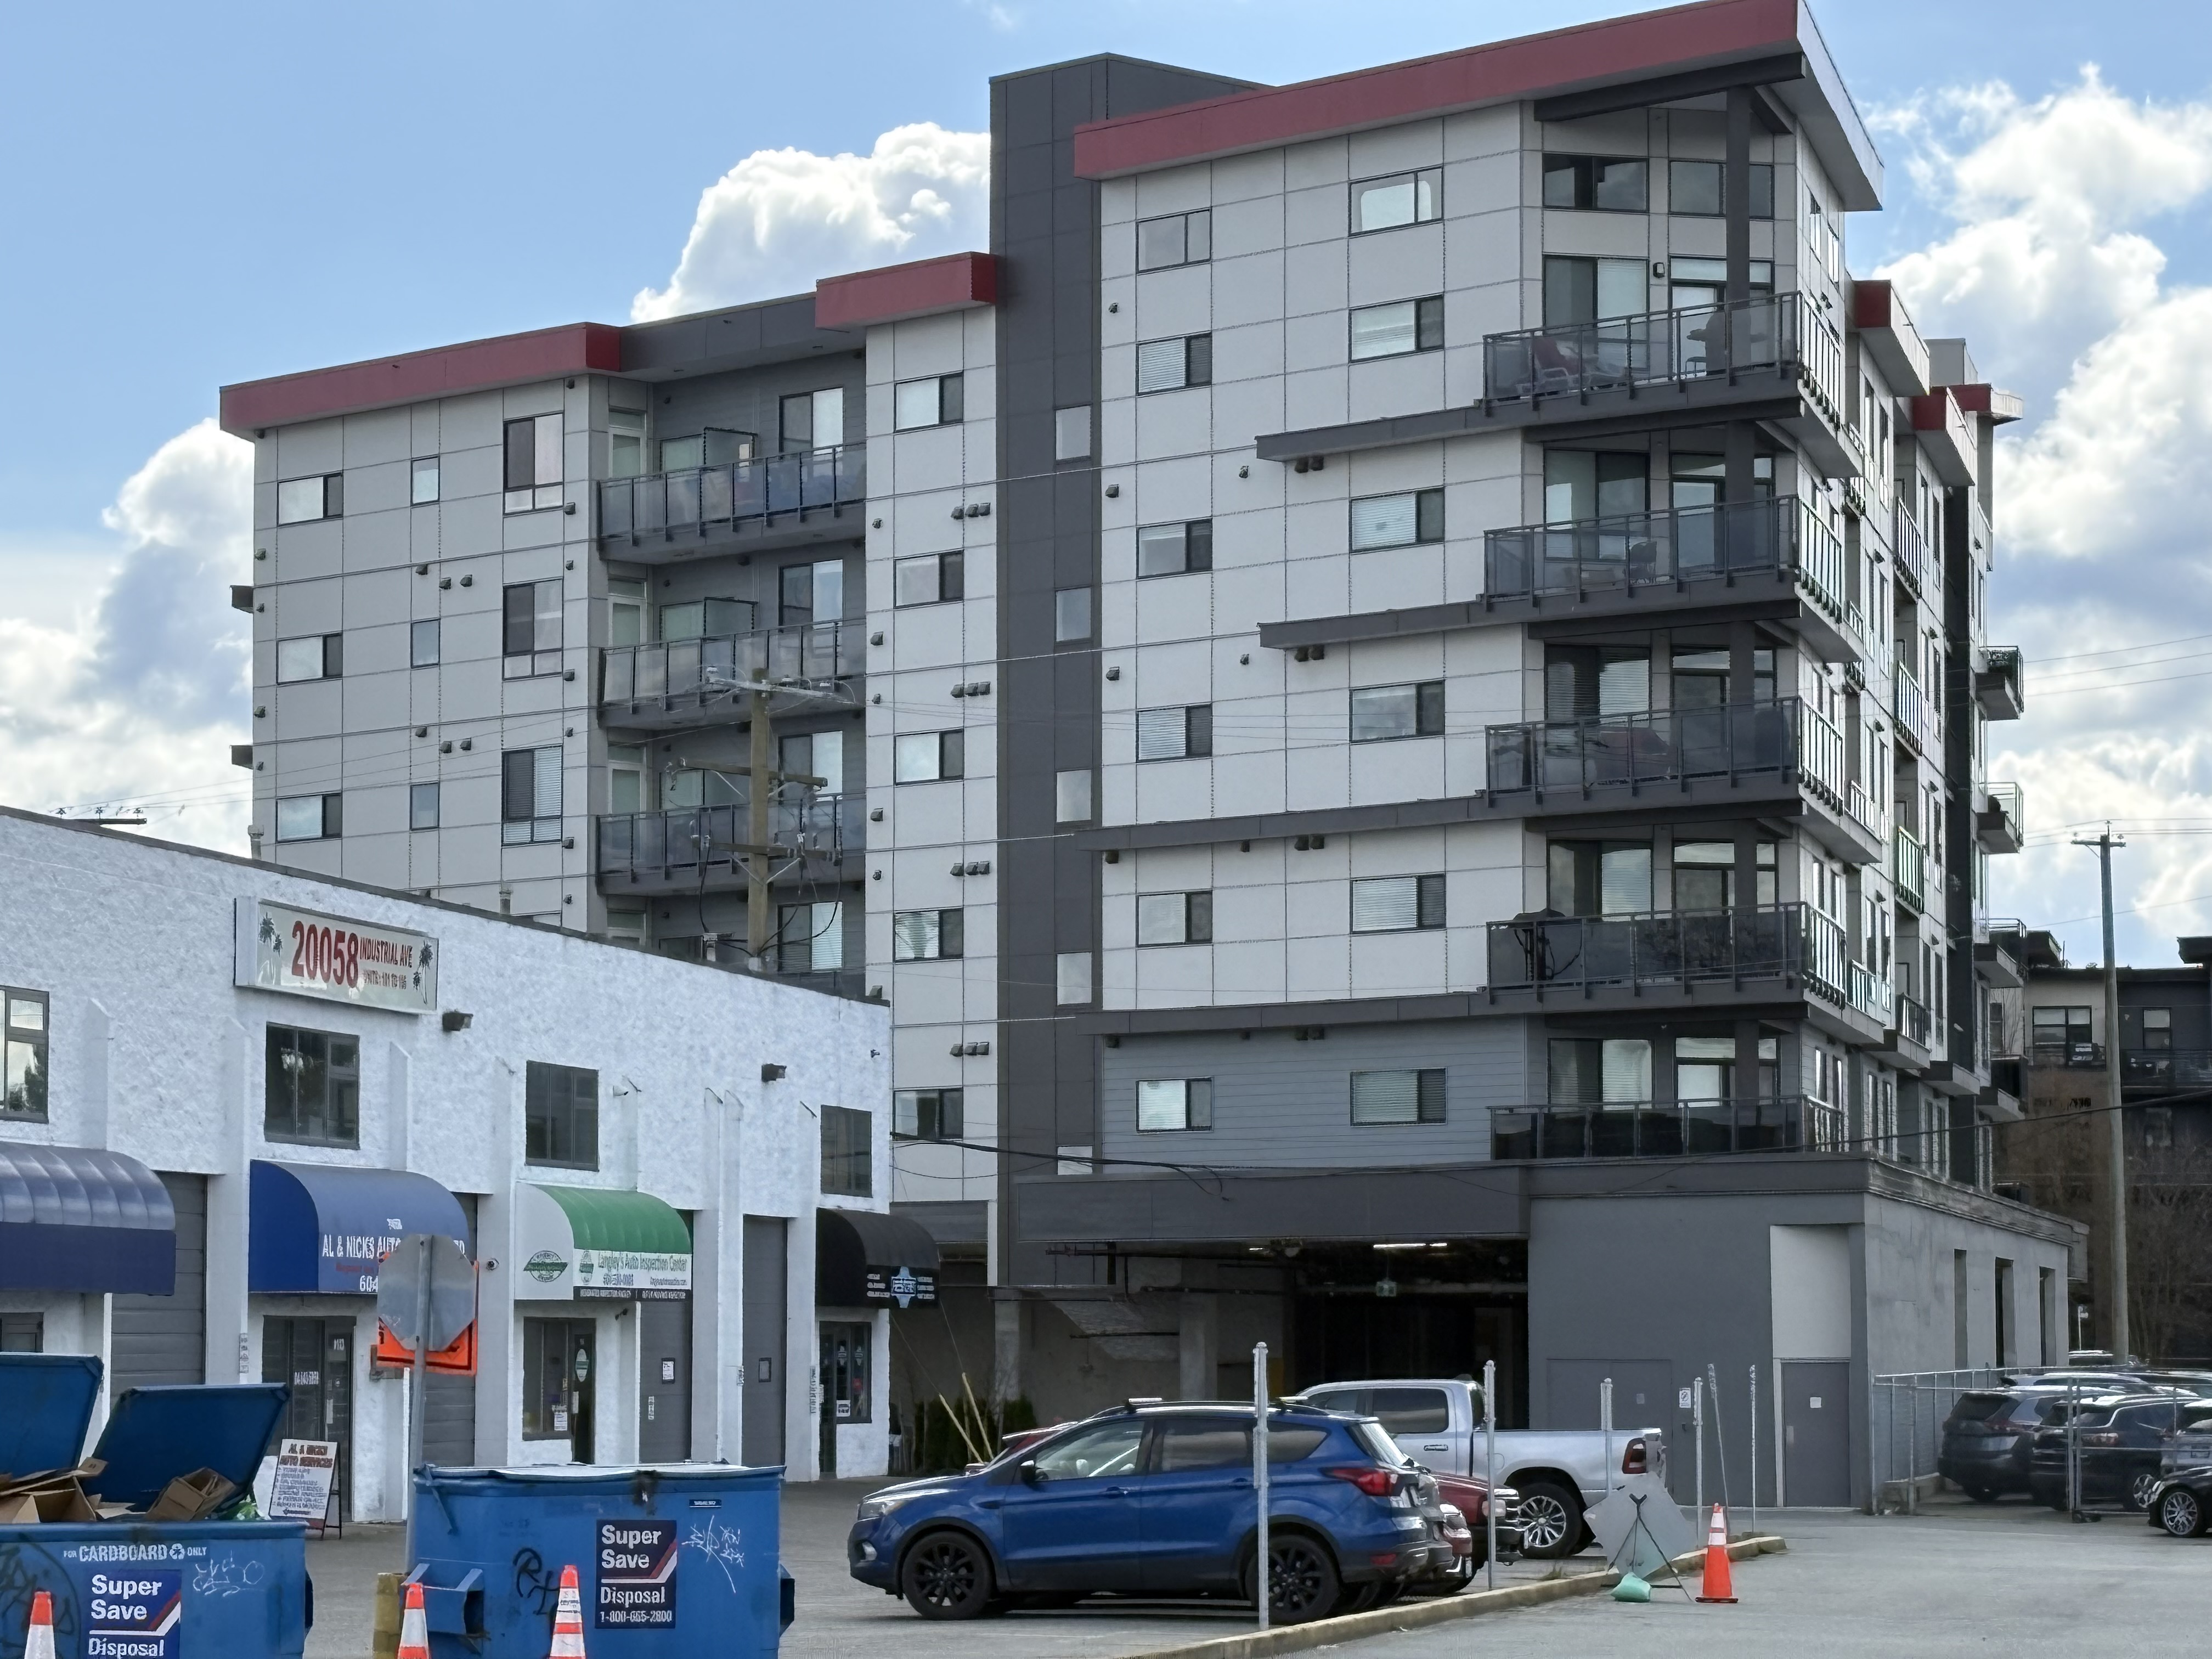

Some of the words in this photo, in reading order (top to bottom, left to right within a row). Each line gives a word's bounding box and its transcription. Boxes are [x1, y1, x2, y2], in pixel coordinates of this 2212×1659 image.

[292, 920, 359, 988] 20058
[359, 936, 398, 966] INDUSTRIAL
[399, 944, 413, 968] AVE
[323, 1234, 334, 1257] AL
[337, 1235, 343, 1258] &
[346, 1235, 374, 1259] NICKS
[601, 1524, 662, 1549] Super
[79, 1544, 168, 1562] CARDBOARD
[187, 1547, 207, 1556] ONLY
[601, 1549, 650, 1569] Save
[92, 1574, 162, 1600] Super
[600, 1586, 665, 1609] Disposal
[91, 1599, 148, 1620] Save
[88, 1638, 165, 1659] Disposal
